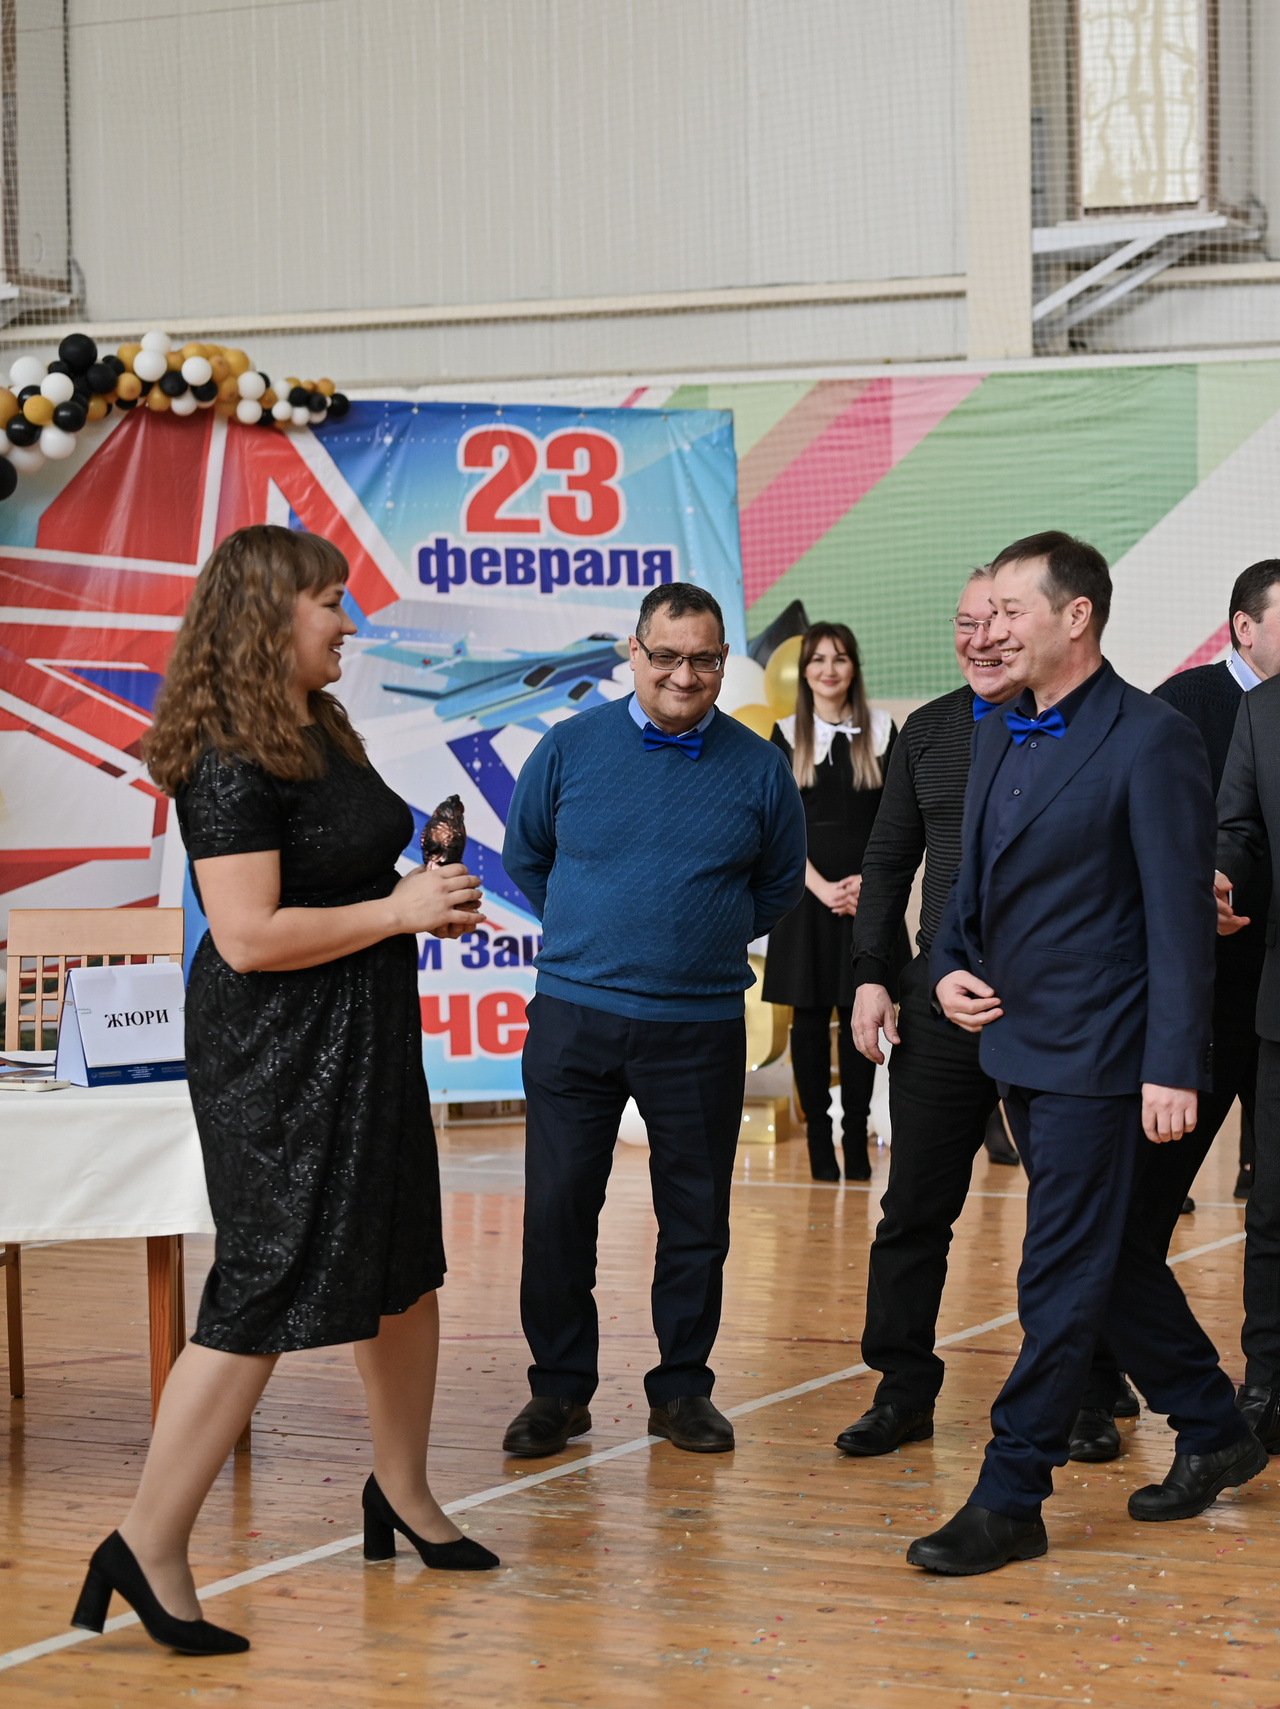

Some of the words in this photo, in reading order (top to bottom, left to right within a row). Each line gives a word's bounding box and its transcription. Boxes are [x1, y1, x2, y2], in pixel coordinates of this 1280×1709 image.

[463, 428, 622, 537] 23
[417, 538, 673, 593] февраля
[104, 1009, 170, 1029] ЖЮРИ
